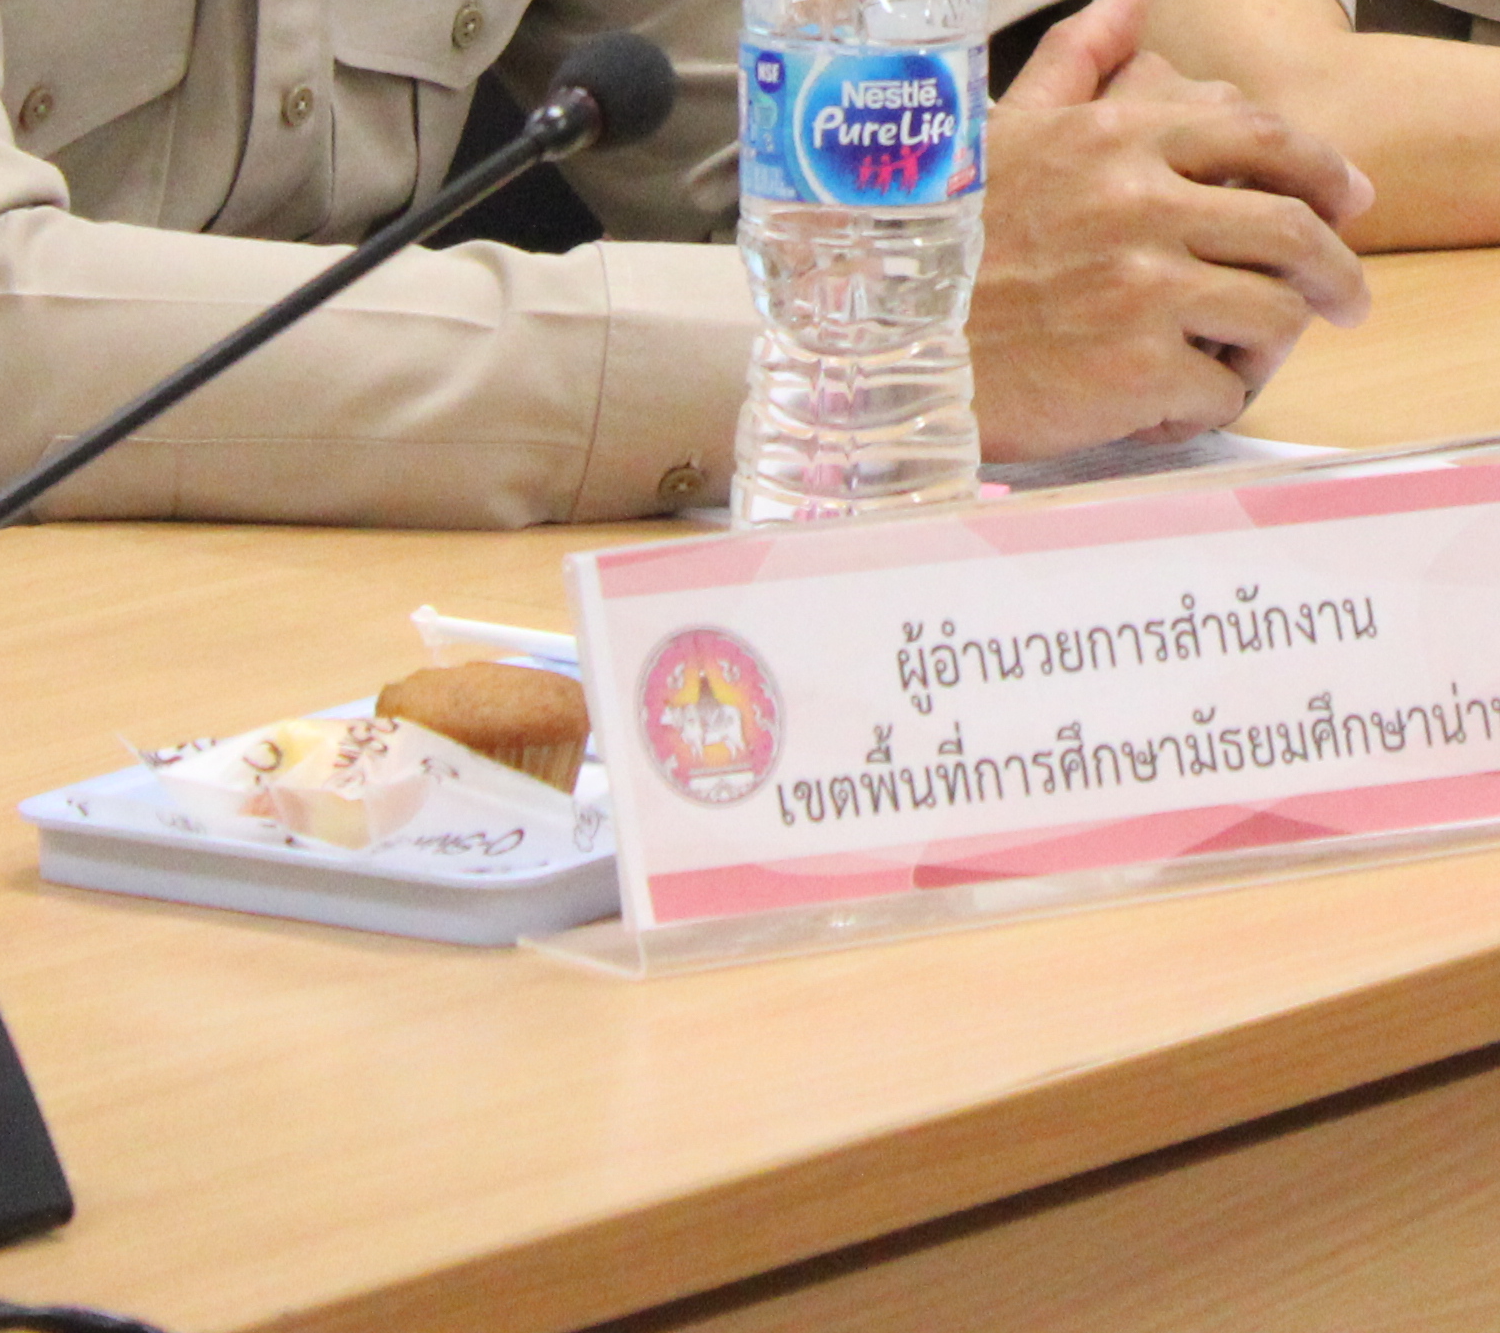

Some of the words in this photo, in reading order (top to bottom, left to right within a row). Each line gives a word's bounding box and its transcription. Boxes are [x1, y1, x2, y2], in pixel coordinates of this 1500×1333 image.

[841, 78, 940, 110] Nestlé
[894, 581, 1379, 717] ผู้อำนวยการสำนักงาน
